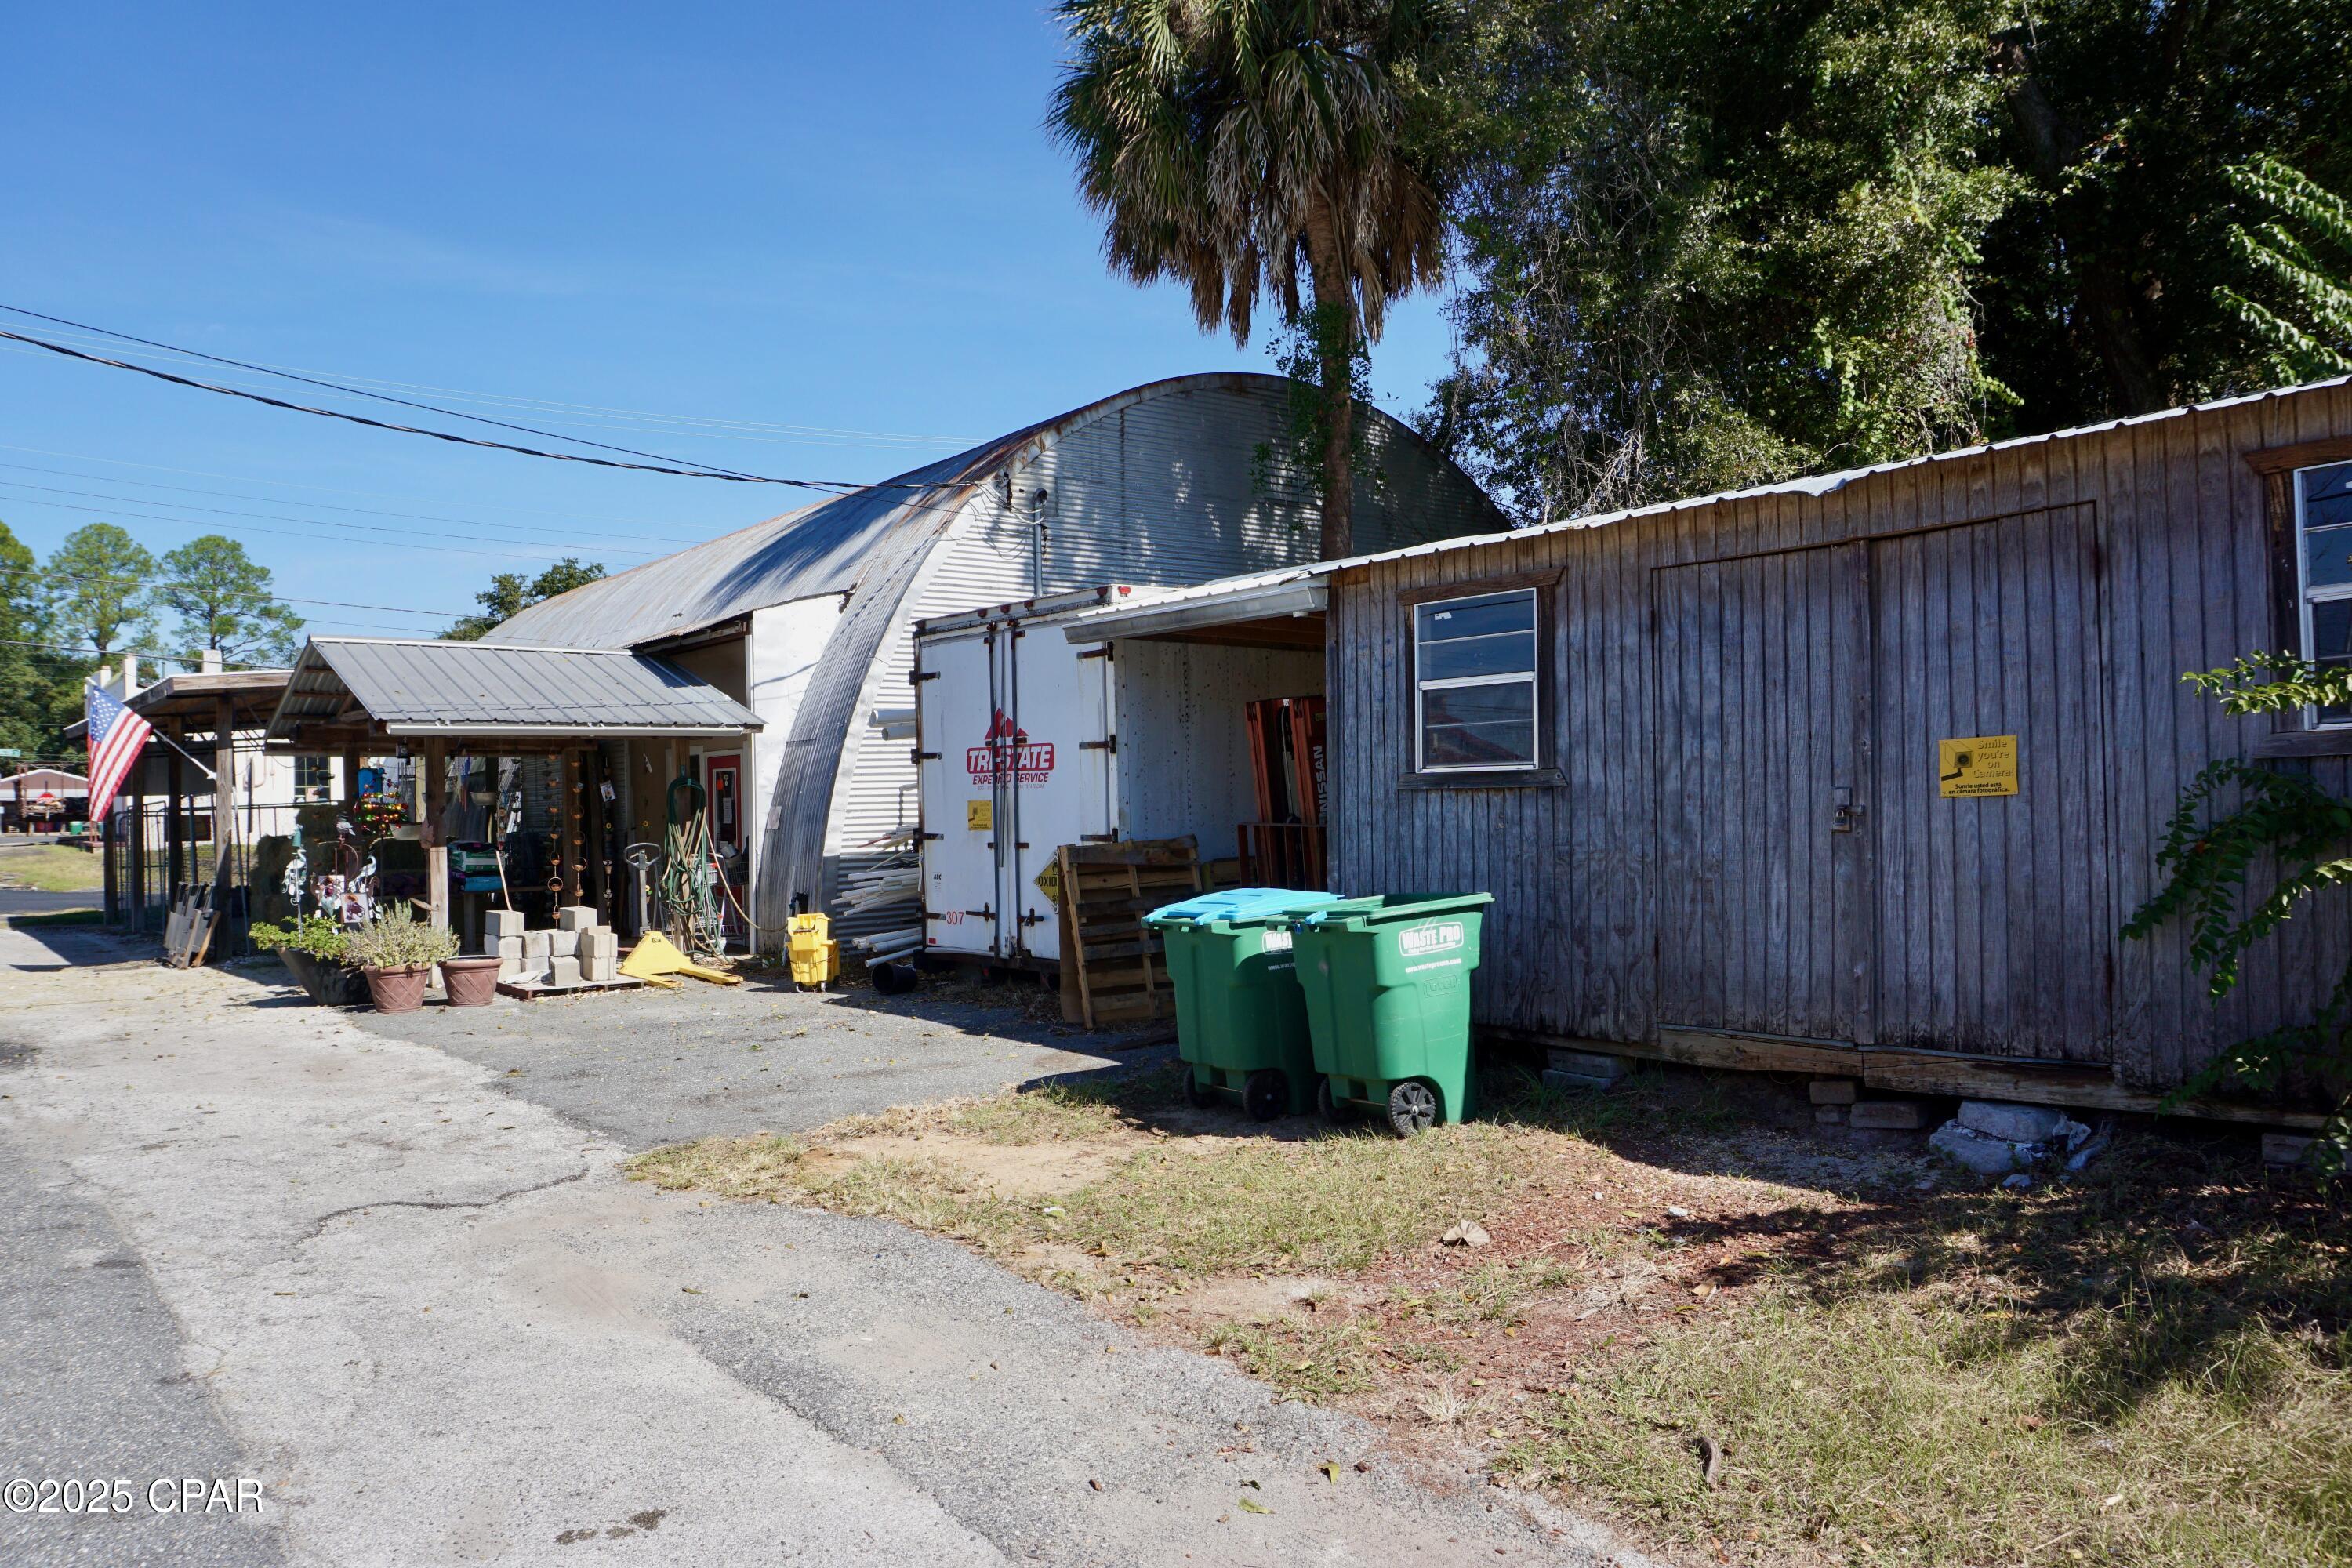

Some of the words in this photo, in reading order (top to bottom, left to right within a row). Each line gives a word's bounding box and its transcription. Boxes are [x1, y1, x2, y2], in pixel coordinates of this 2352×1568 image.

[1978, 739, 2007, 750] Smile
[1978, 750, 2009, 762] you're
[1973, 768, 2014, 779] Camera!
[1312, 746, 1327, 816] NISSAN
[1038, 875, 1058, 887] OXID
[946, 910, 964, 925] 307
[1402, 929, 1437, 949] WASTE
[1439, 925, 1461, 943] PRO
